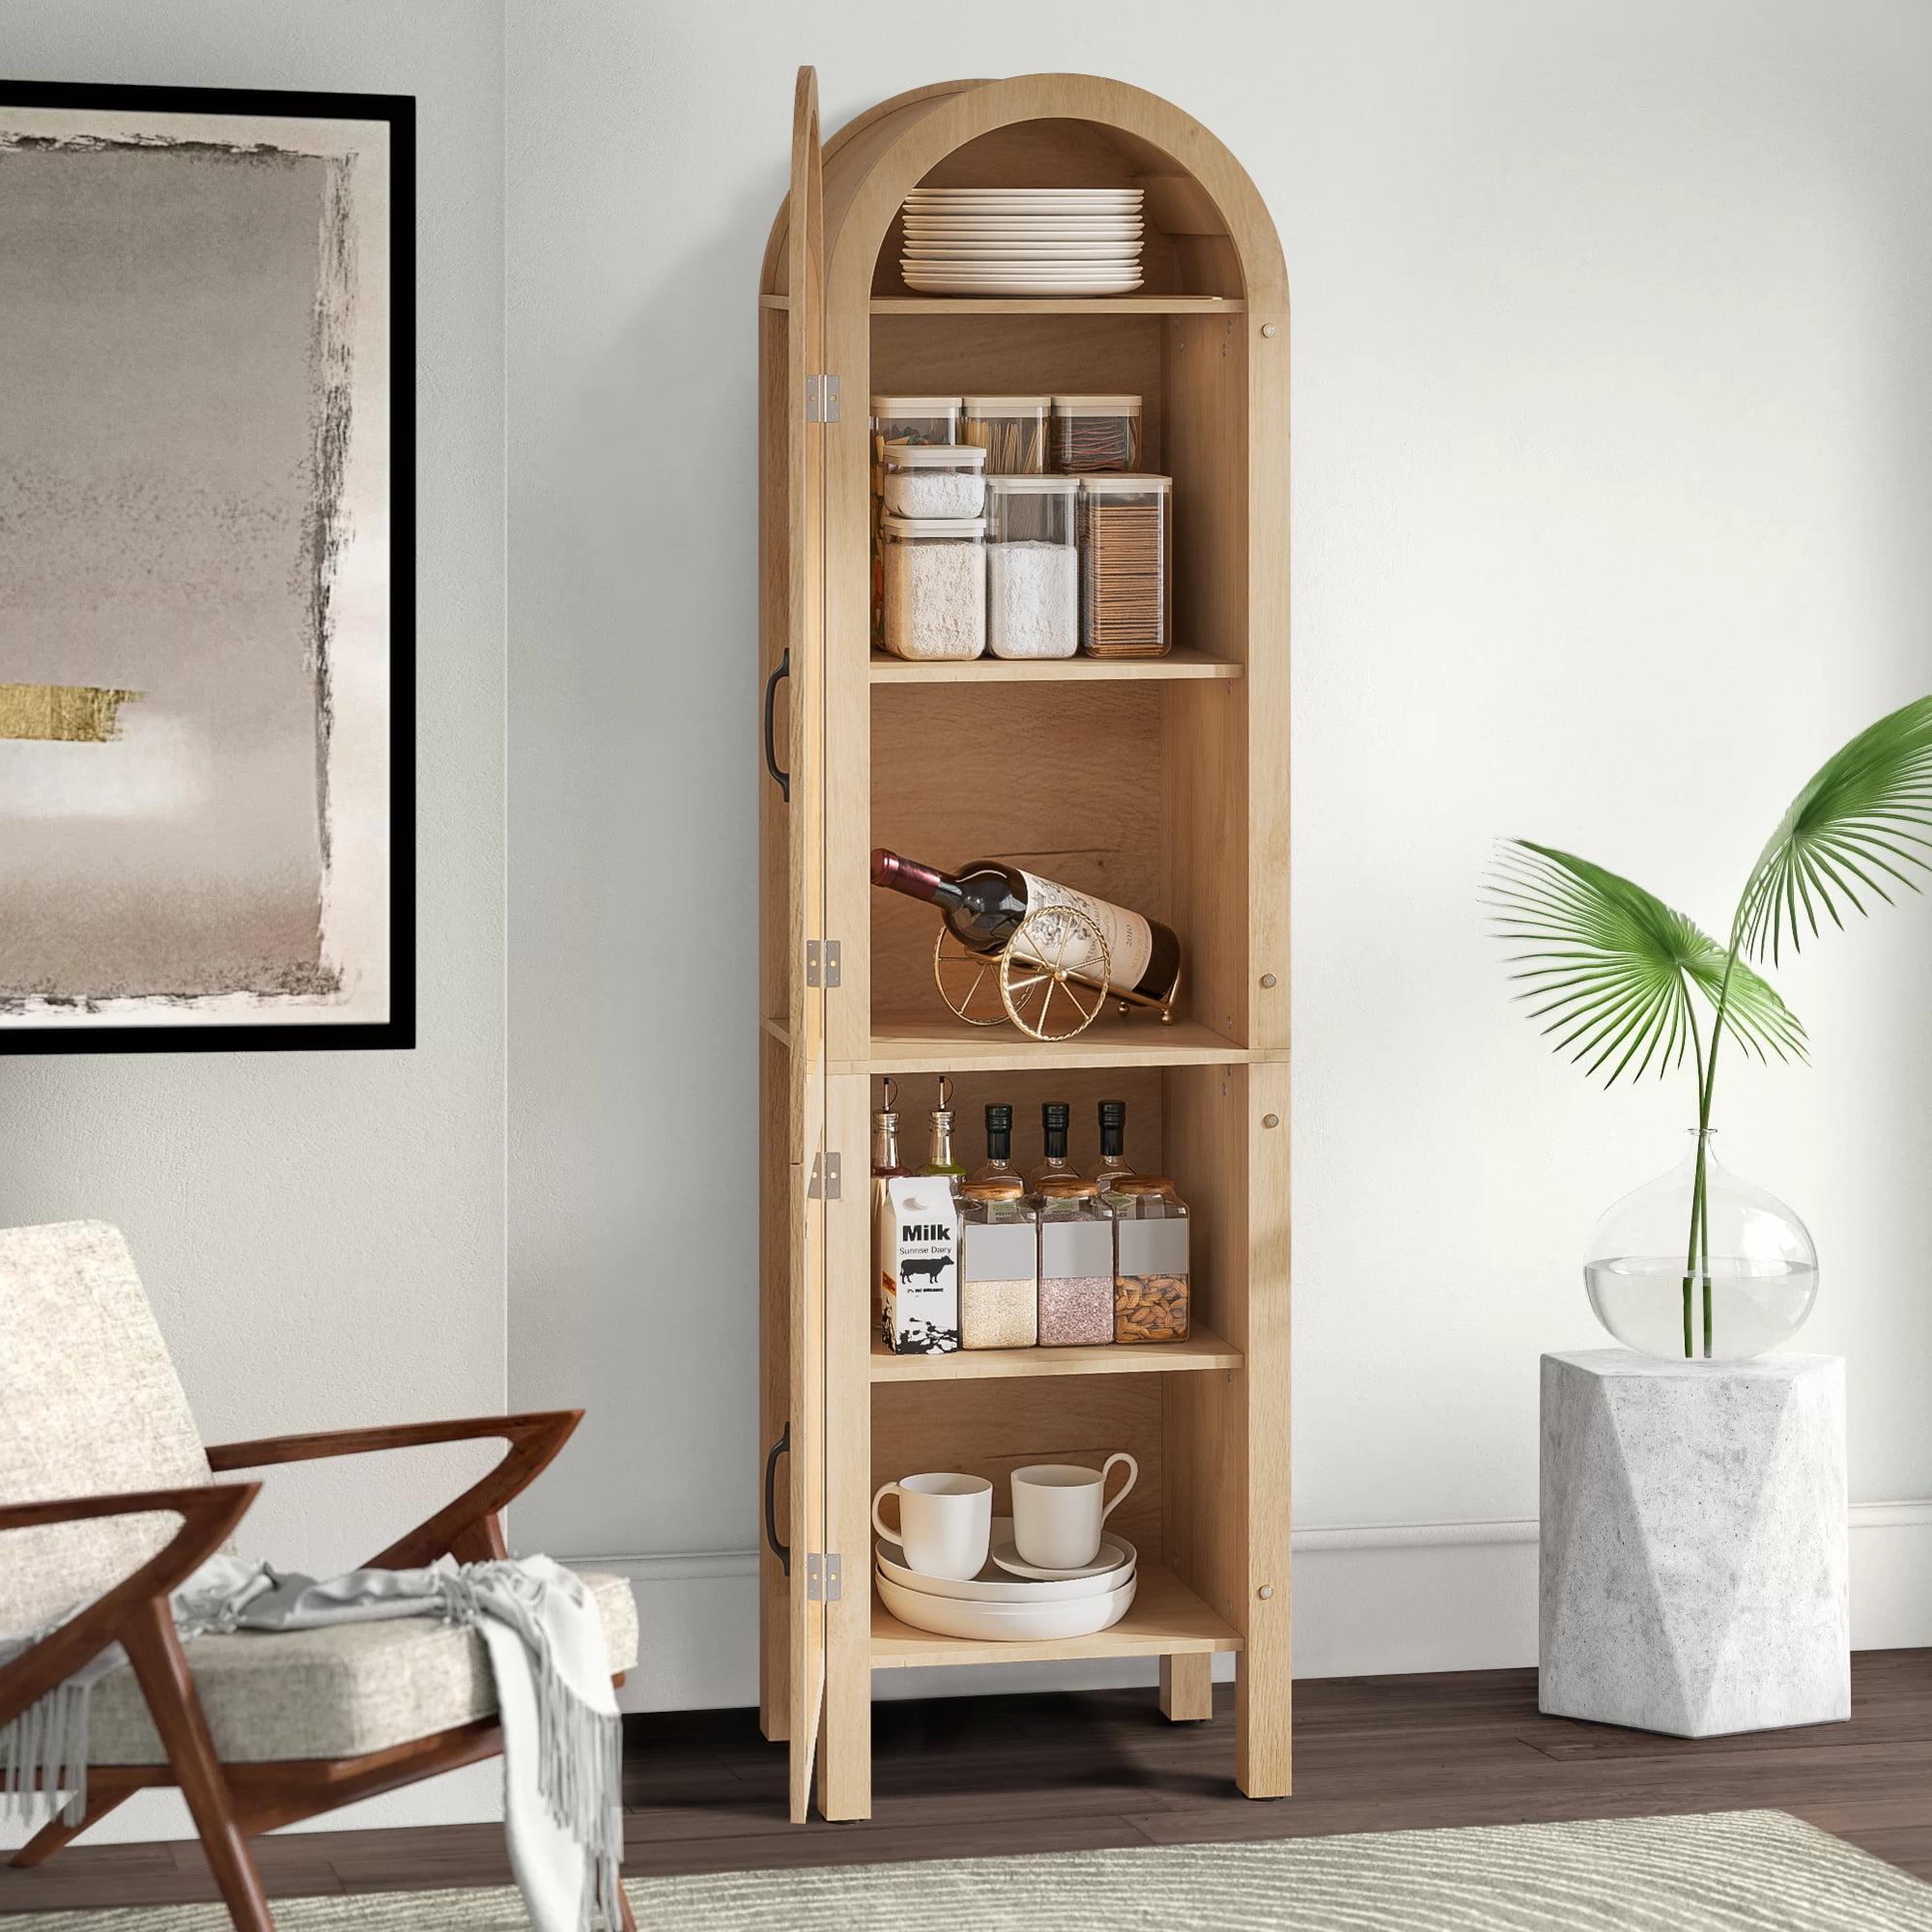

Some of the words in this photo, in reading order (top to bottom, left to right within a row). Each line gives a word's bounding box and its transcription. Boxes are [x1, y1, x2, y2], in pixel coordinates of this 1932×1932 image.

[902, 1224, 952, 1242] Milk
[899, 1246, 929, 1255] Sunrise
[931, 1245, 952, 1255] Dairy
